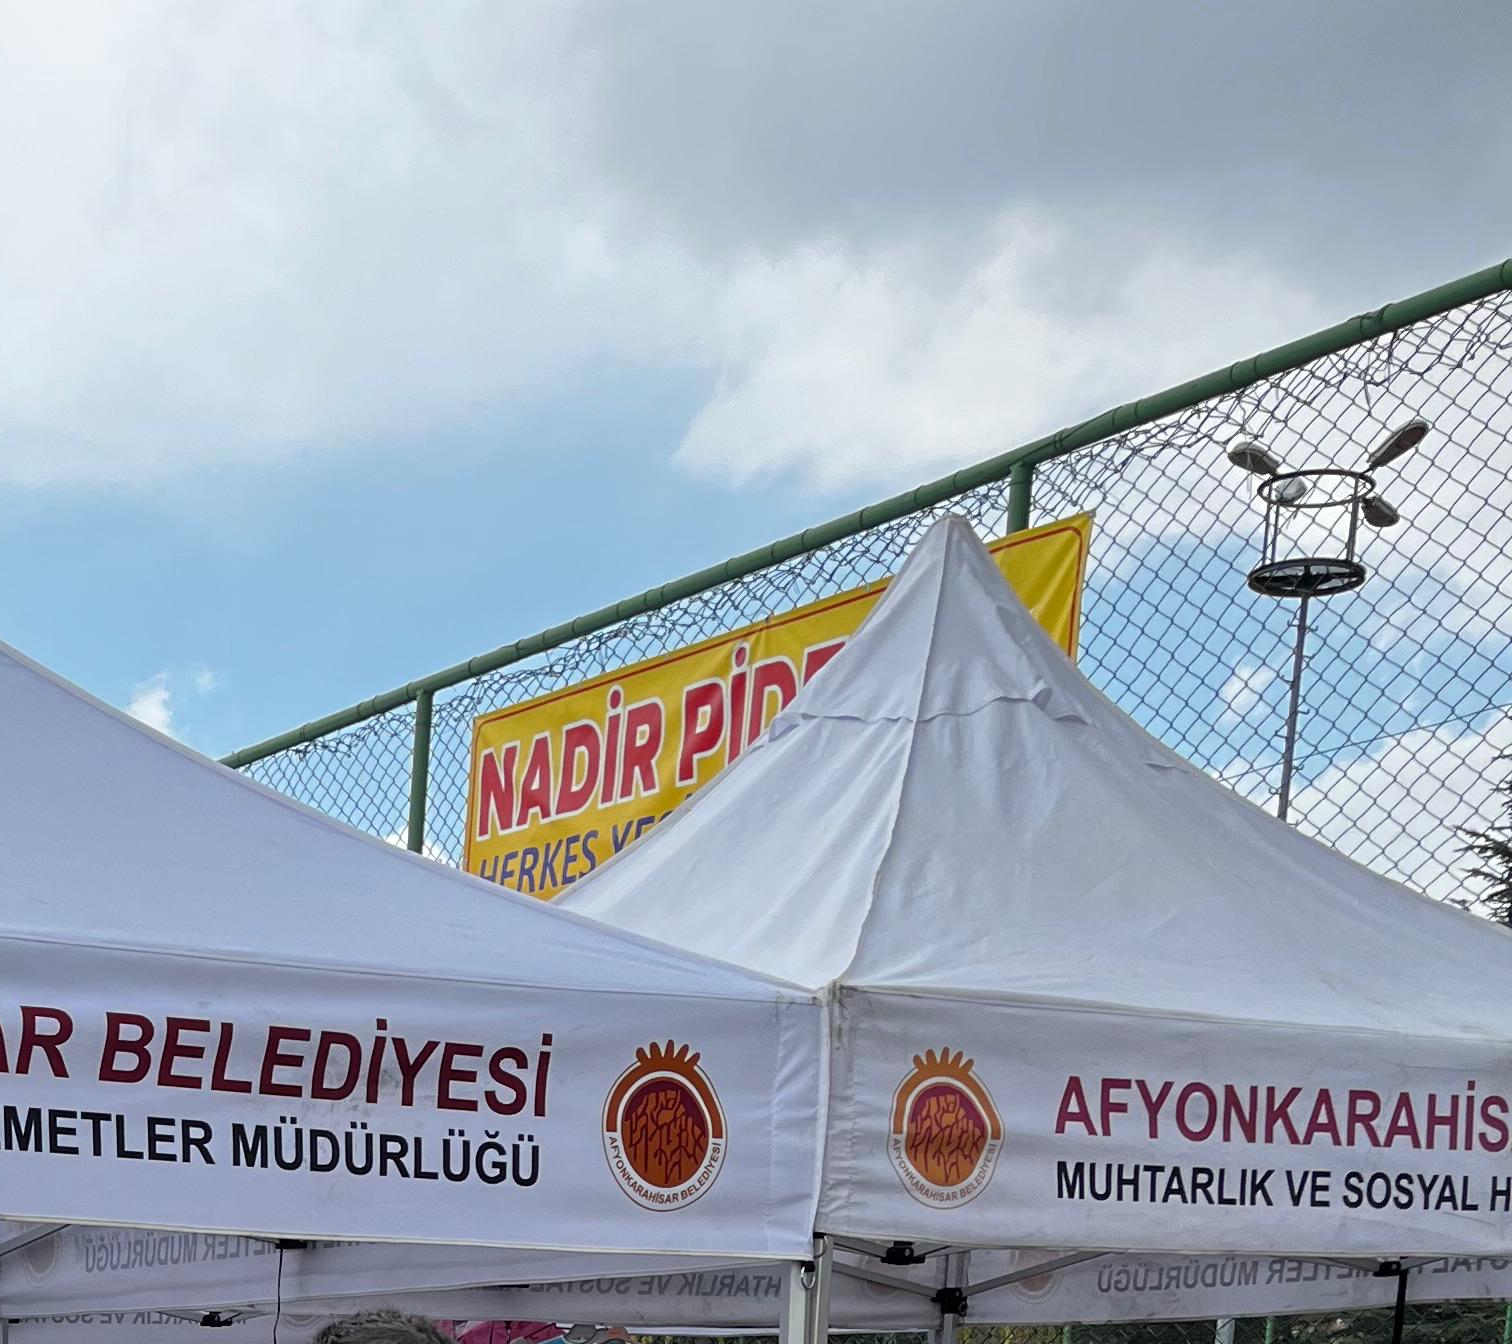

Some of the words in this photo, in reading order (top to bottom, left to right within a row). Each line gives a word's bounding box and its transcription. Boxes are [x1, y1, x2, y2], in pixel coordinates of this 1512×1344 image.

[476, 684, 664, 842] NADİR
[479, 829, 600, 892] HERKES
[612, 810, 674, 854] YE
[99, 1011, 553, 1117] BELEDİYESİ
[232, 1116, 540, 1187] MÜDÜRLÜĞÜ
[1056, 1160, 1276, 1207] MUHTARLIK
[1285, 1169, 1332, 1208] VE
[1342, 1171, 1479, 1212] SOSYAL
